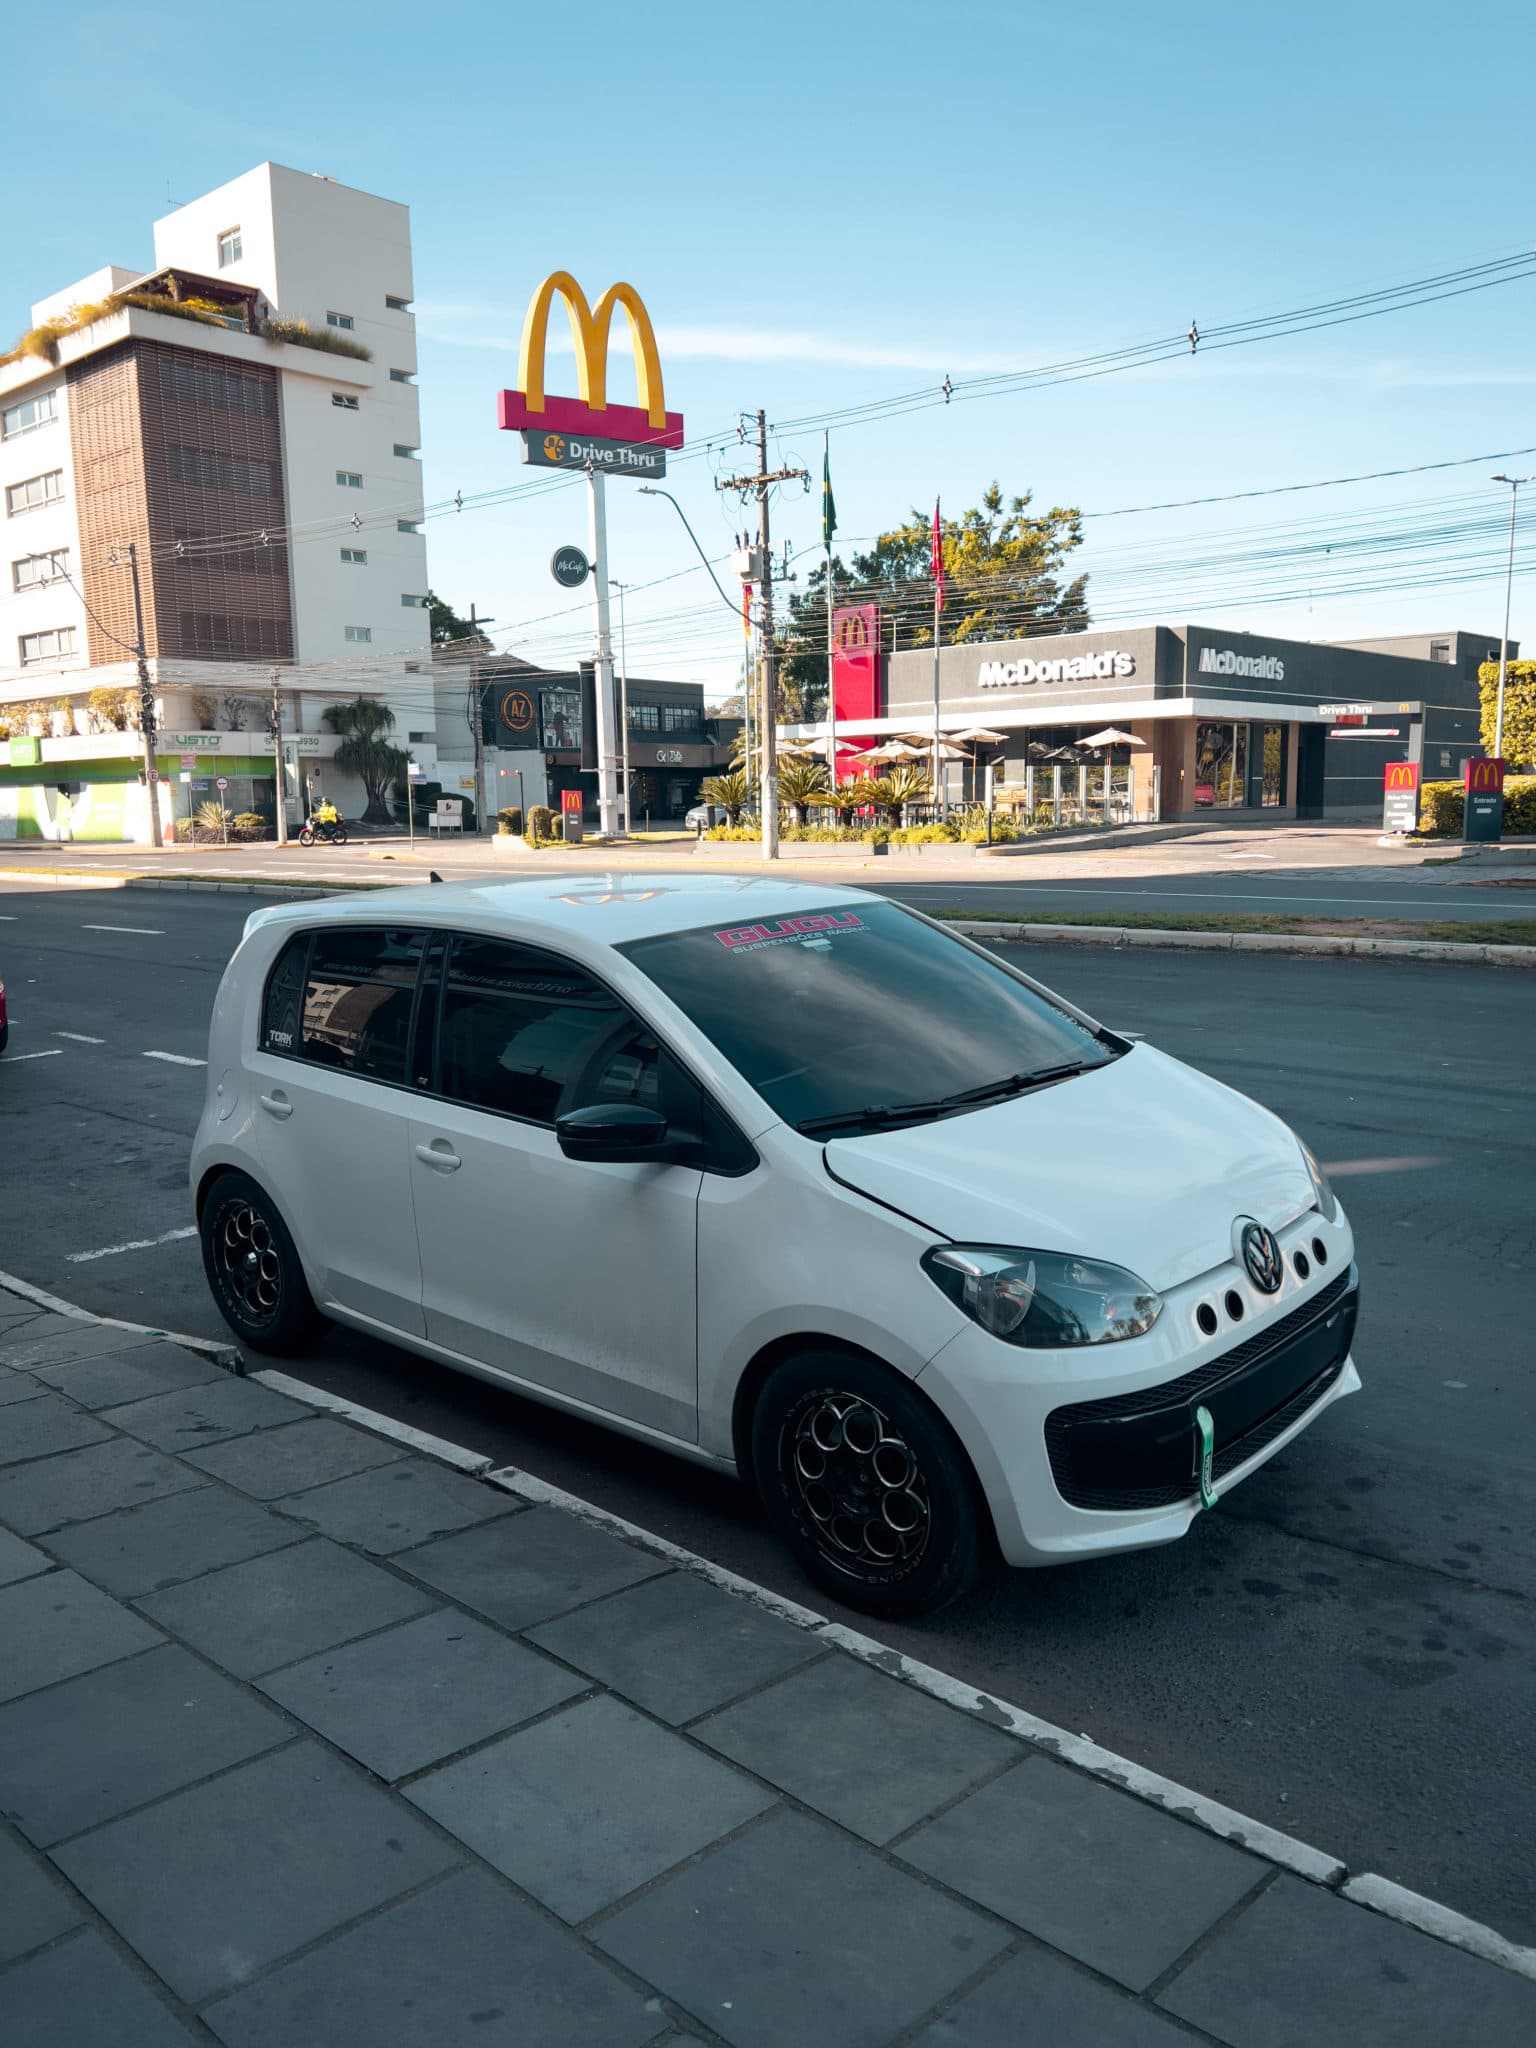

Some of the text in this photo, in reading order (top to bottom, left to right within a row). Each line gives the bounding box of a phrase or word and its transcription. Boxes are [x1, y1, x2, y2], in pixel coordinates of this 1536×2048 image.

[570, 442, 655, 467] Drive Thru
[978, 650, 1134, 687] McDonald's
[1198, 648, 1285, 680] McDonald's
[511, 700, 526, 717] AZ
[1319, 705, 1346, 714] Drive
[1348, 704, 1373, 713] Thru
[713, 912, 864, 947] GUGU
[270, 1030, 293, 1046] TORK
